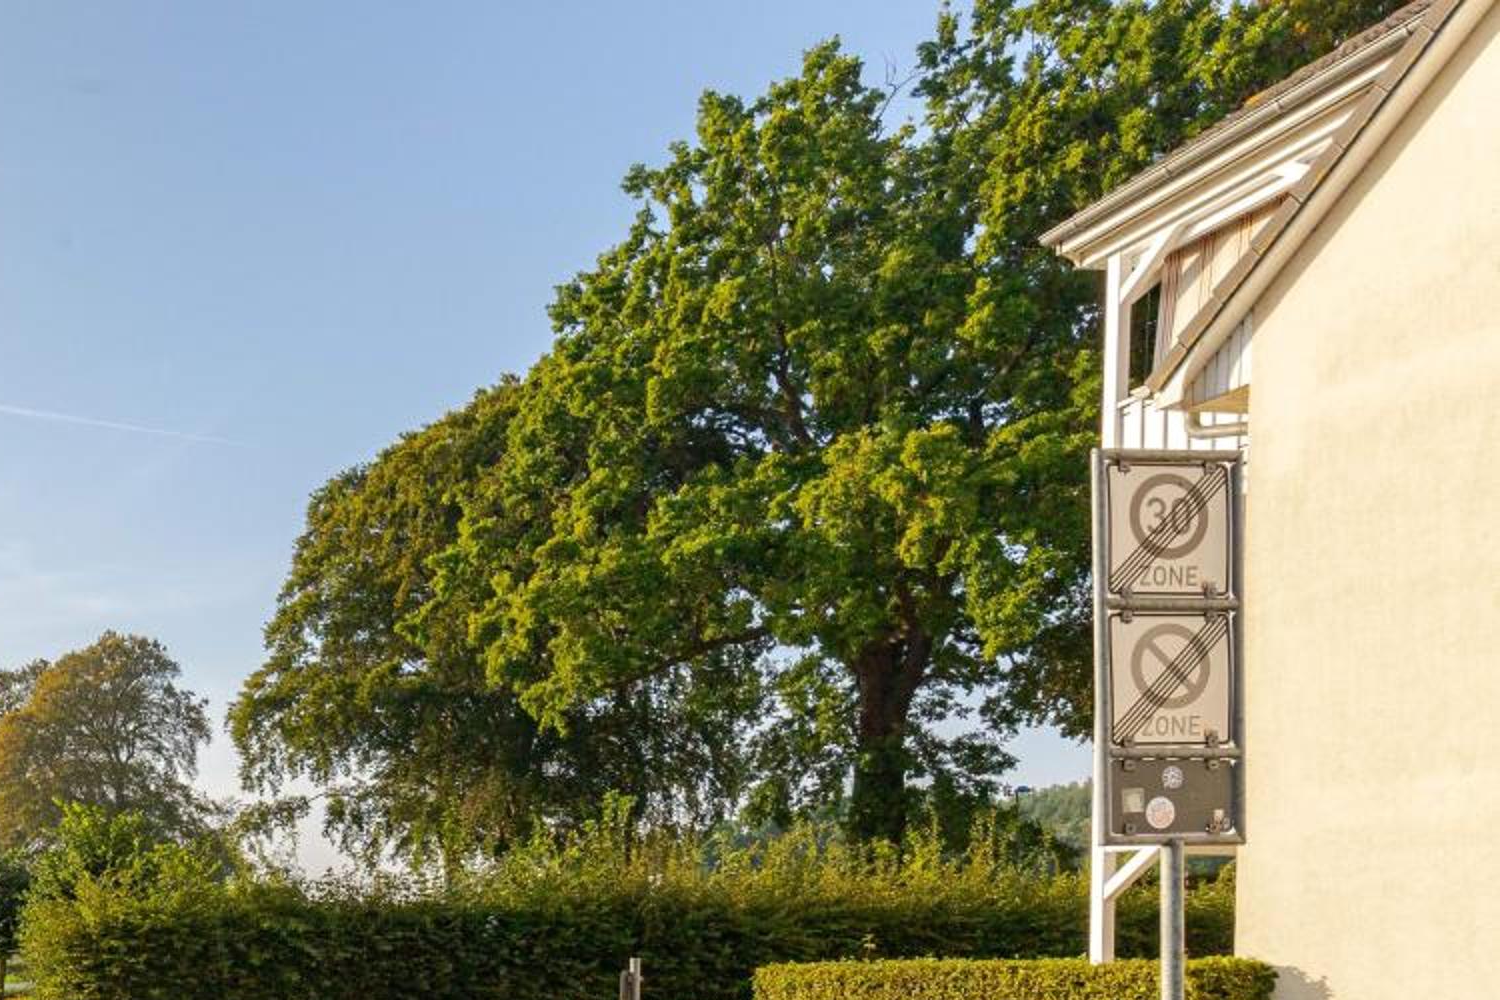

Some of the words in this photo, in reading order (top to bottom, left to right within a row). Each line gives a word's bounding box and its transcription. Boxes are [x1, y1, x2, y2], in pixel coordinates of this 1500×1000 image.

[1146, 497, 1191, 536] 30
[1139, 565, 1199, 587] ZONE
[1141, 715, 1202, 737] ZONE
